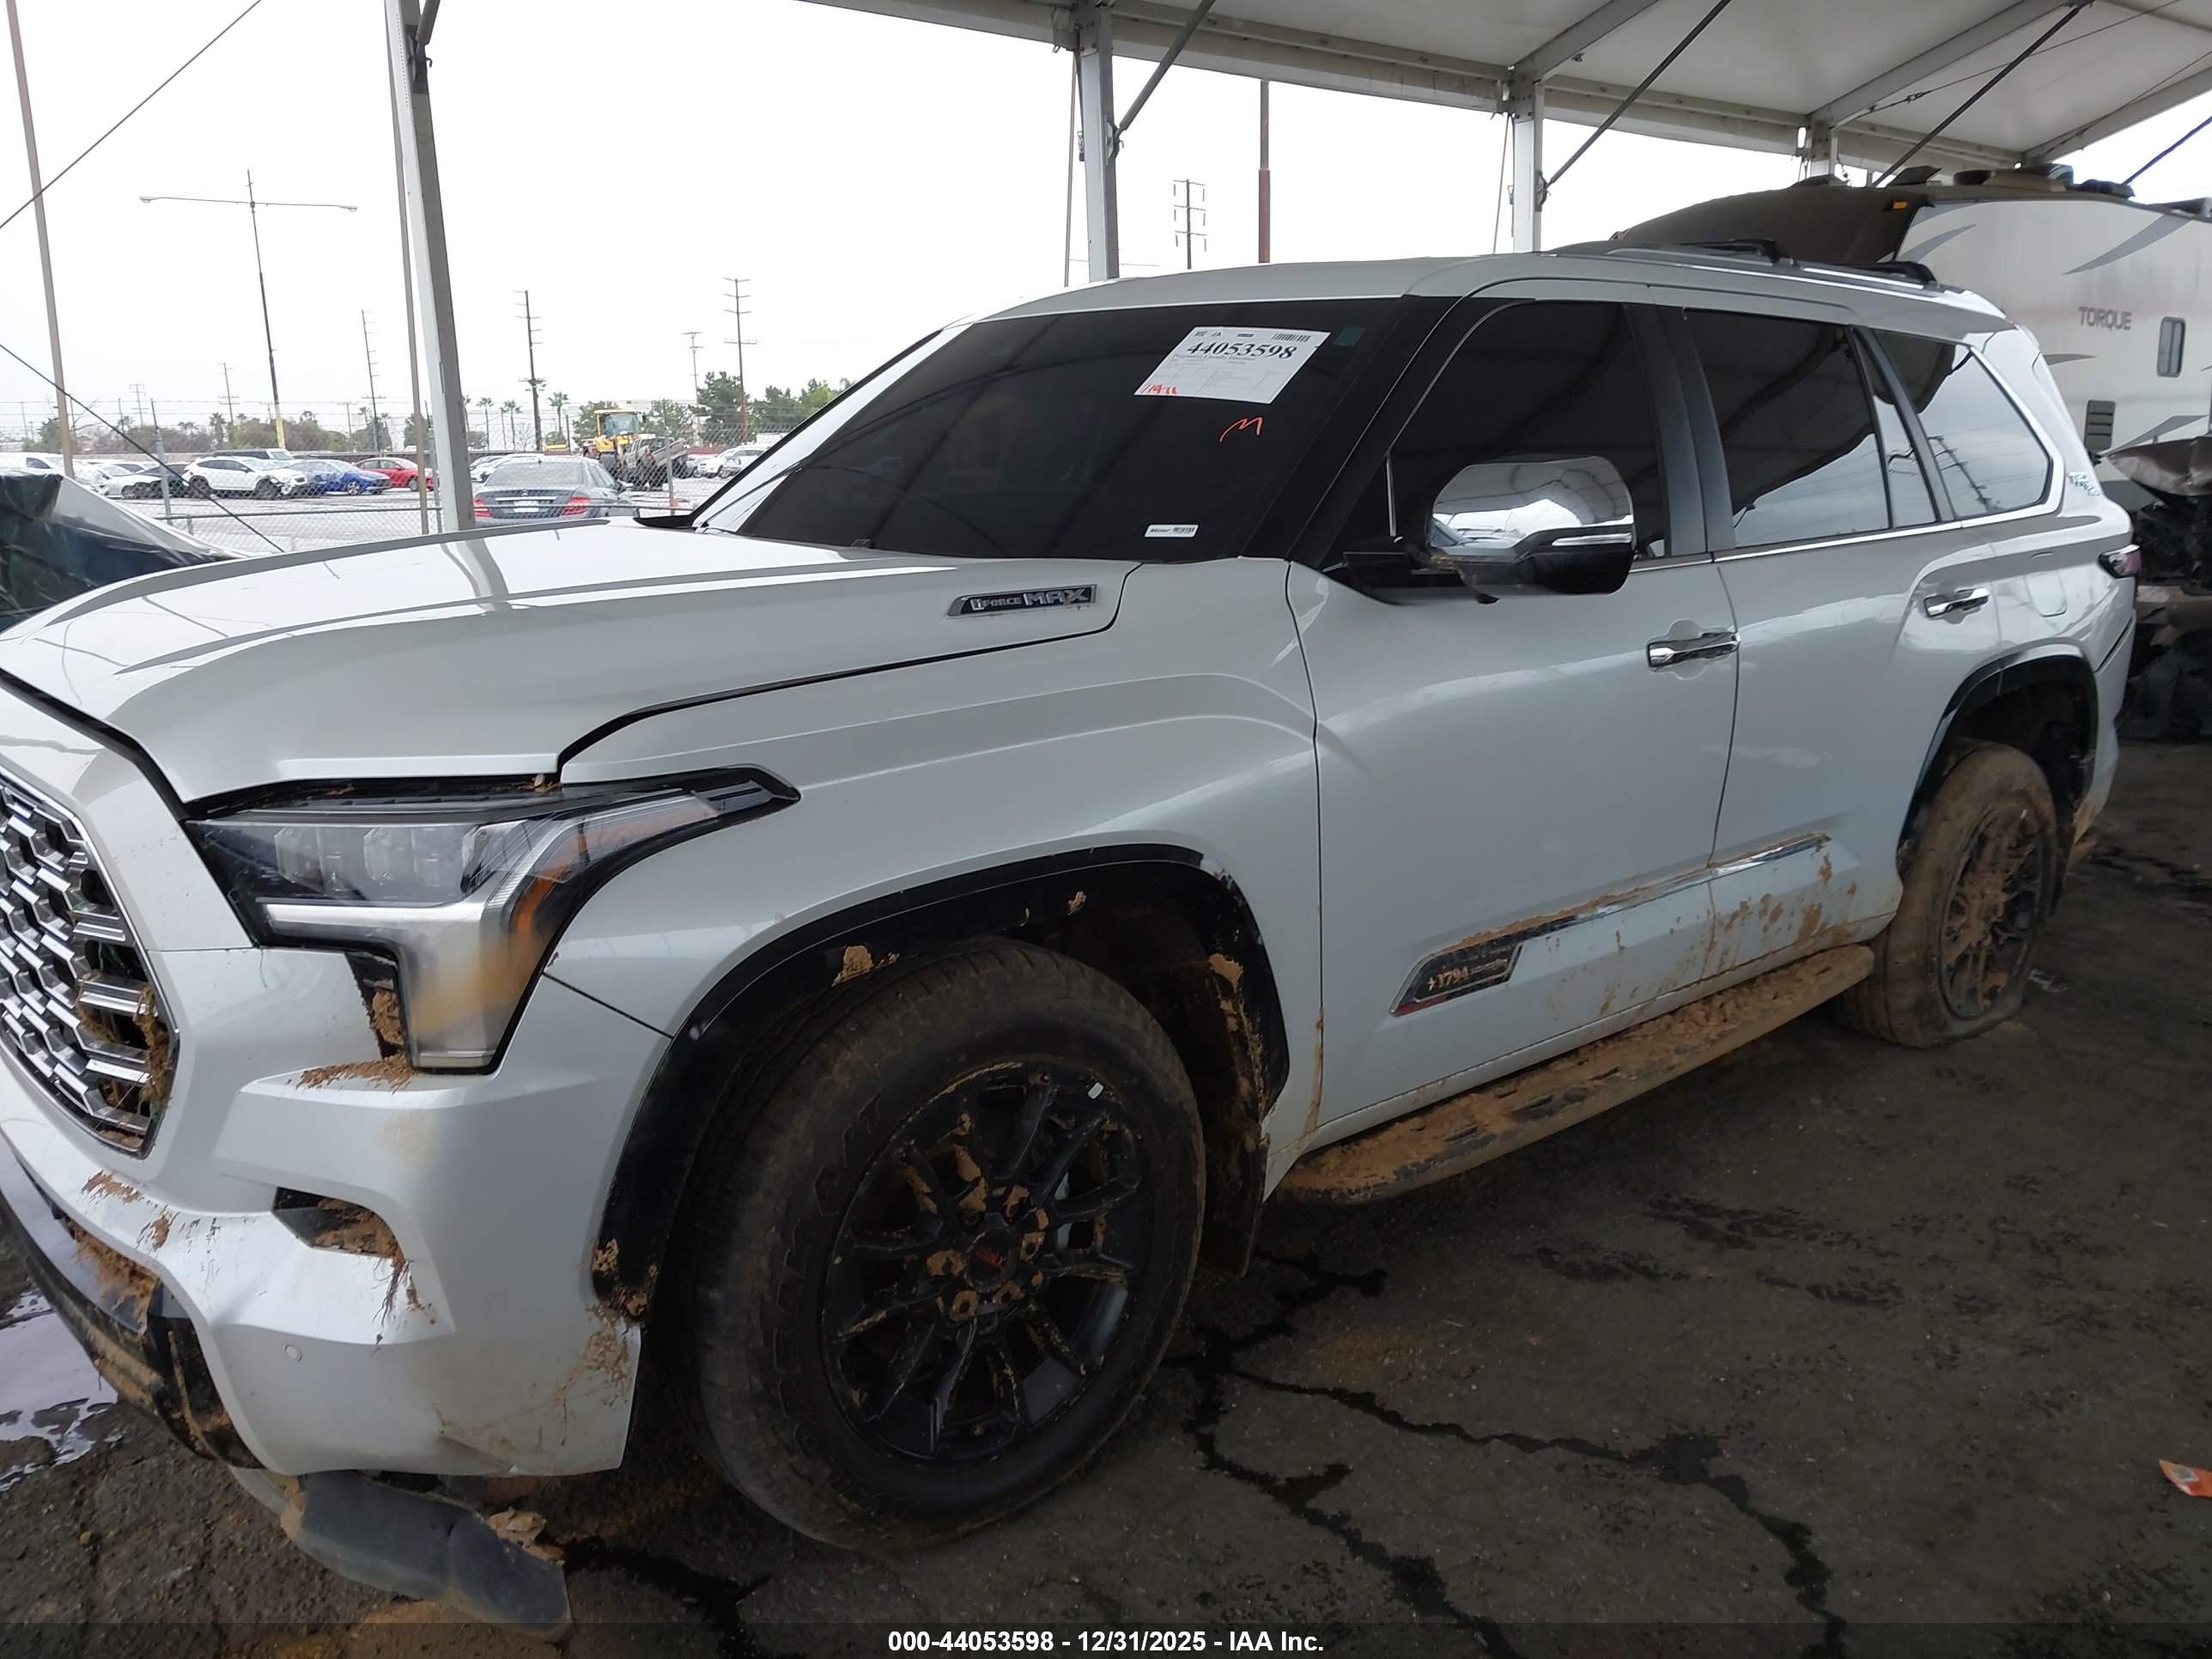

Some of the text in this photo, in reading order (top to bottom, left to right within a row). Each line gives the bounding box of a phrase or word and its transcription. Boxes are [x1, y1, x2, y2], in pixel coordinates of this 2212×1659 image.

[2078, 306, 2132, 331] TORQUE
[1186, 341, 1297, 360] 44053598
[1023, 587, 1089, 606] MAX
[1436, 965, 1471, 988] 1794
